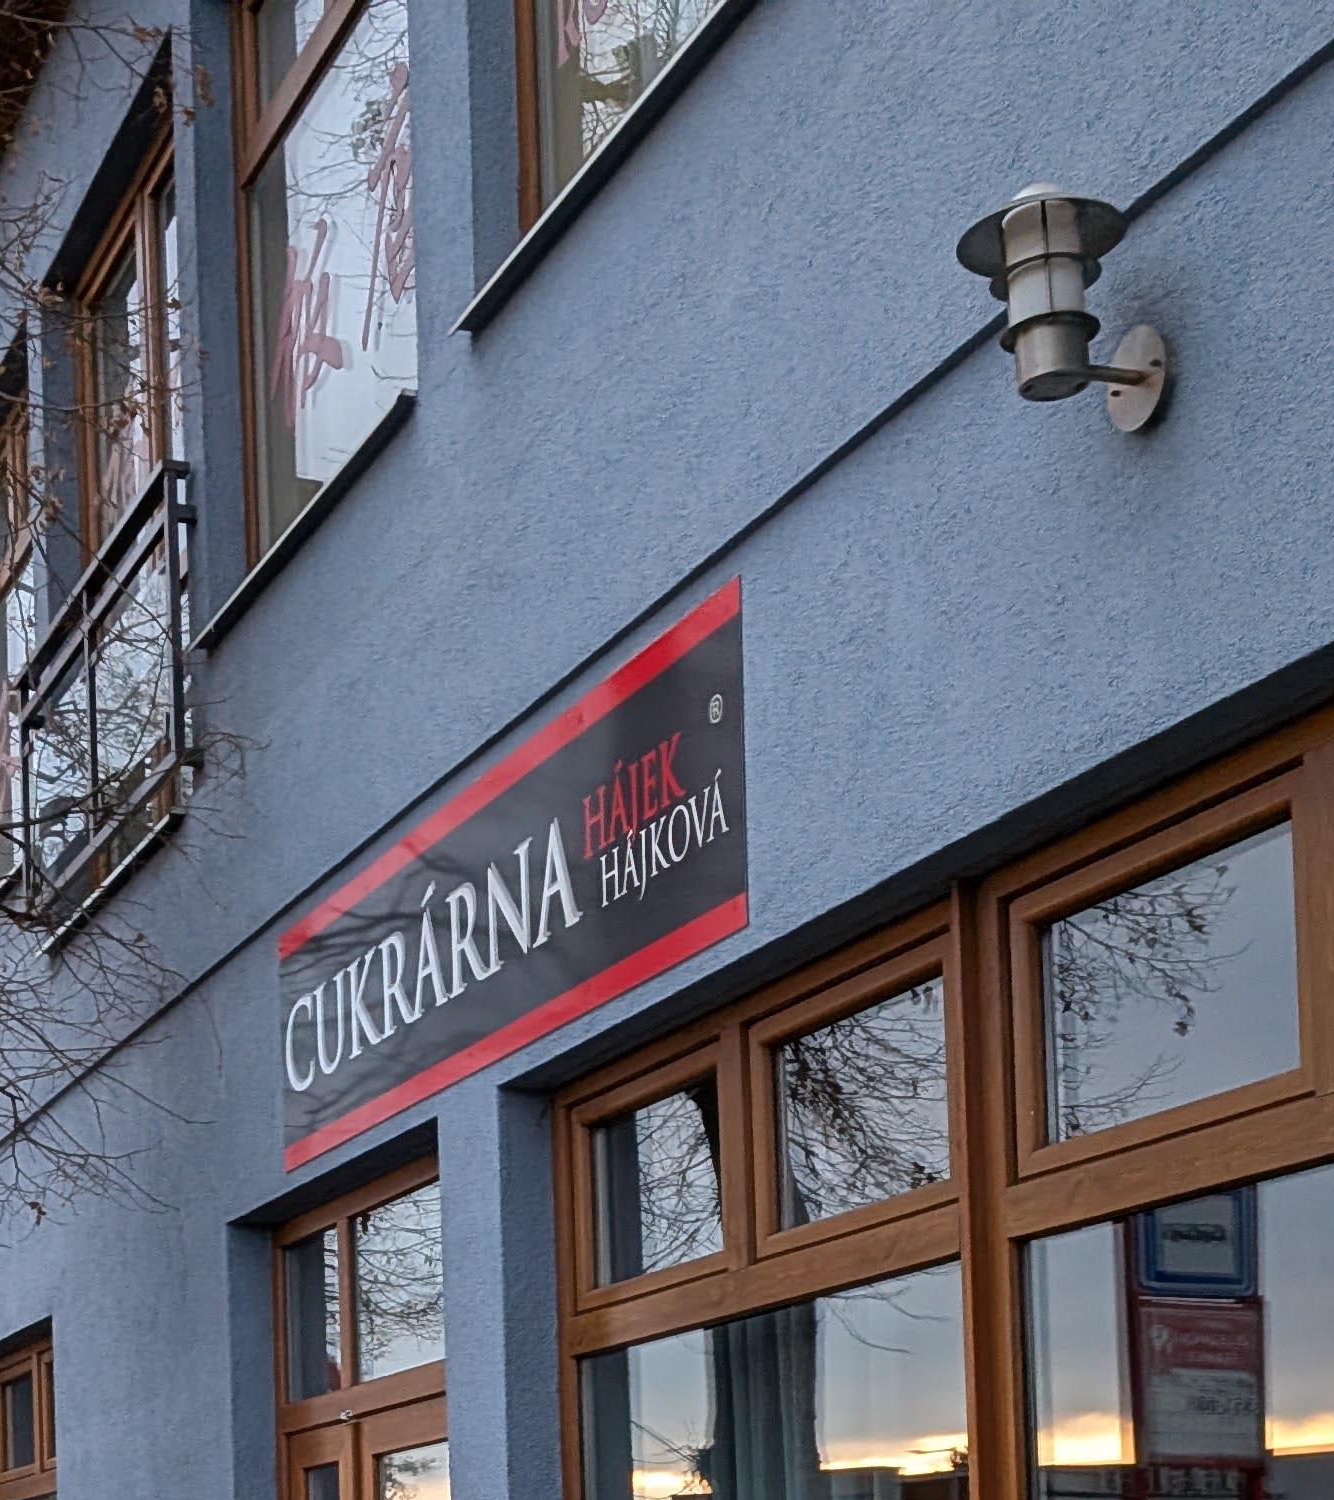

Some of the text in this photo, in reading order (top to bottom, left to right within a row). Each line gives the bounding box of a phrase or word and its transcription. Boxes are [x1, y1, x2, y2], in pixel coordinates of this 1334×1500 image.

[581, 731, 686, 860] HÁJEK
[600, 768, 730, 908] HÁJKOVÁ
[285, 816, 584, 1092] CUKRÁRNA
